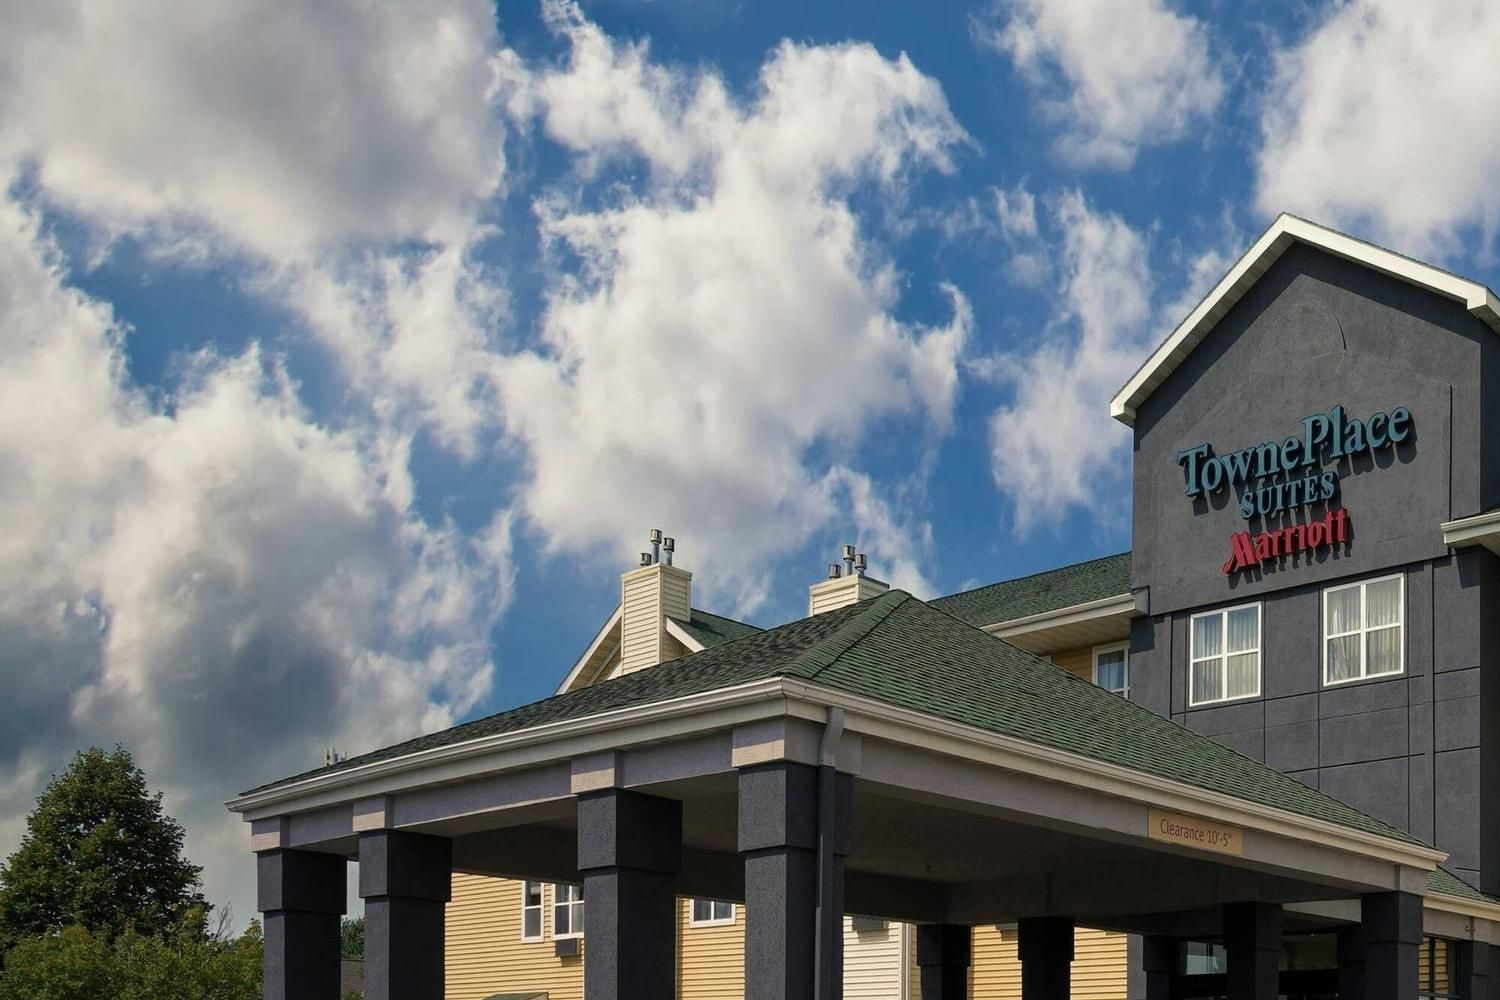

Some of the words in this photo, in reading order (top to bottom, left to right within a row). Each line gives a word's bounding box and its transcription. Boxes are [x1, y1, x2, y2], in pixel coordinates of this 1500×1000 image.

[1240, 470, 1336, 519] SUITES
[1222, 507, 1349, 575] Marriott
[1160, 818, 1205, 842] Clearance
